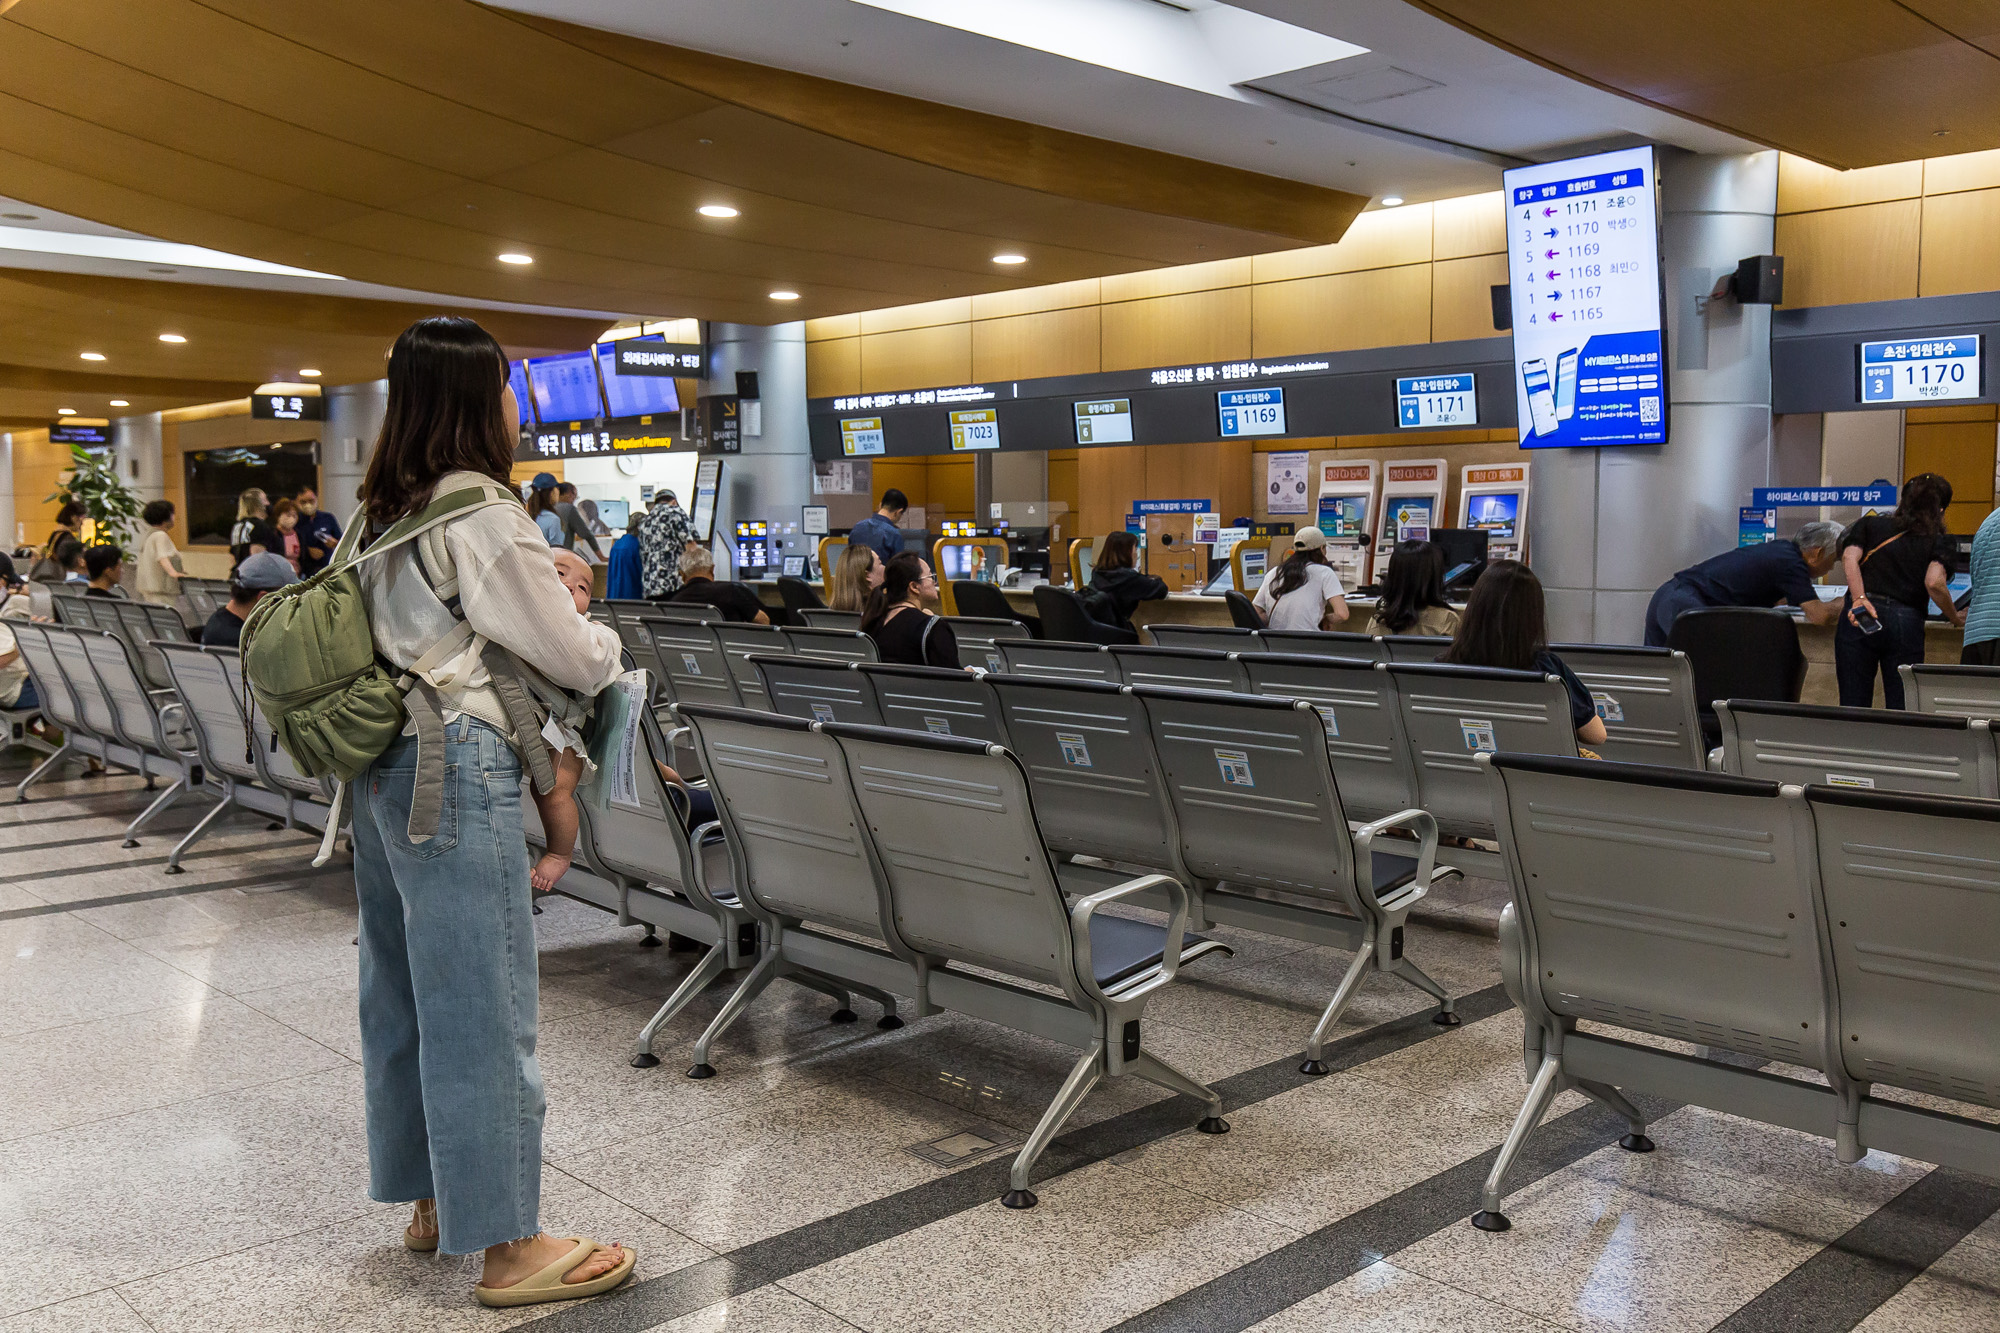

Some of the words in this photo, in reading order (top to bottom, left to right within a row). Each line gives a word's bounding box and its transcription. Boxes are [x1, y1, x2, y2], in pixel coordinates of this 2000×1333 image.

[1523, 209, 1531, 221] 4
[1567, 200, 1597, 215] 1171
[1525, 230, 1532, 243] 3
[1567, 221, 1599, 237] 1170
[1526, 251, 1534, 263] 5
[1569, 243, 1600, 258] 1169
[1527, 272, 1535, 284] 4
[1570, 264, 1601, 280] 1168
[1529, 293, 1535, 304] 1
[1571, 286, 1602, 300] 1167
[1529, 313, 1537, 325] 4
[1572, 307, 1604, 321] 1165
[1151, 367, 1194, 385] 처음오신분
[1906, 363, 1965, 385] 1170
[1874, 379, 1884, 394] 3
[1427, 396, 1464, 413] 1171
[1244, 408, 1276, 424] 1169
[1406, 408, 1415, 420] 4
[968, 425, 993, 440] 7023
[1082, 426, 1089, 438] 6
[1226, 418, 1234, 430] 5
[538, 434, 559, 456] 약국
[643, 435, 672, 449] Pharmacy
[956, 434, 962, 444] 7
[1766, 491, 1839, 502] 하이패스(후불결제)
[1842, 491, 1860, 501] 가입
[1863, 490, 1882, 500] 창구
